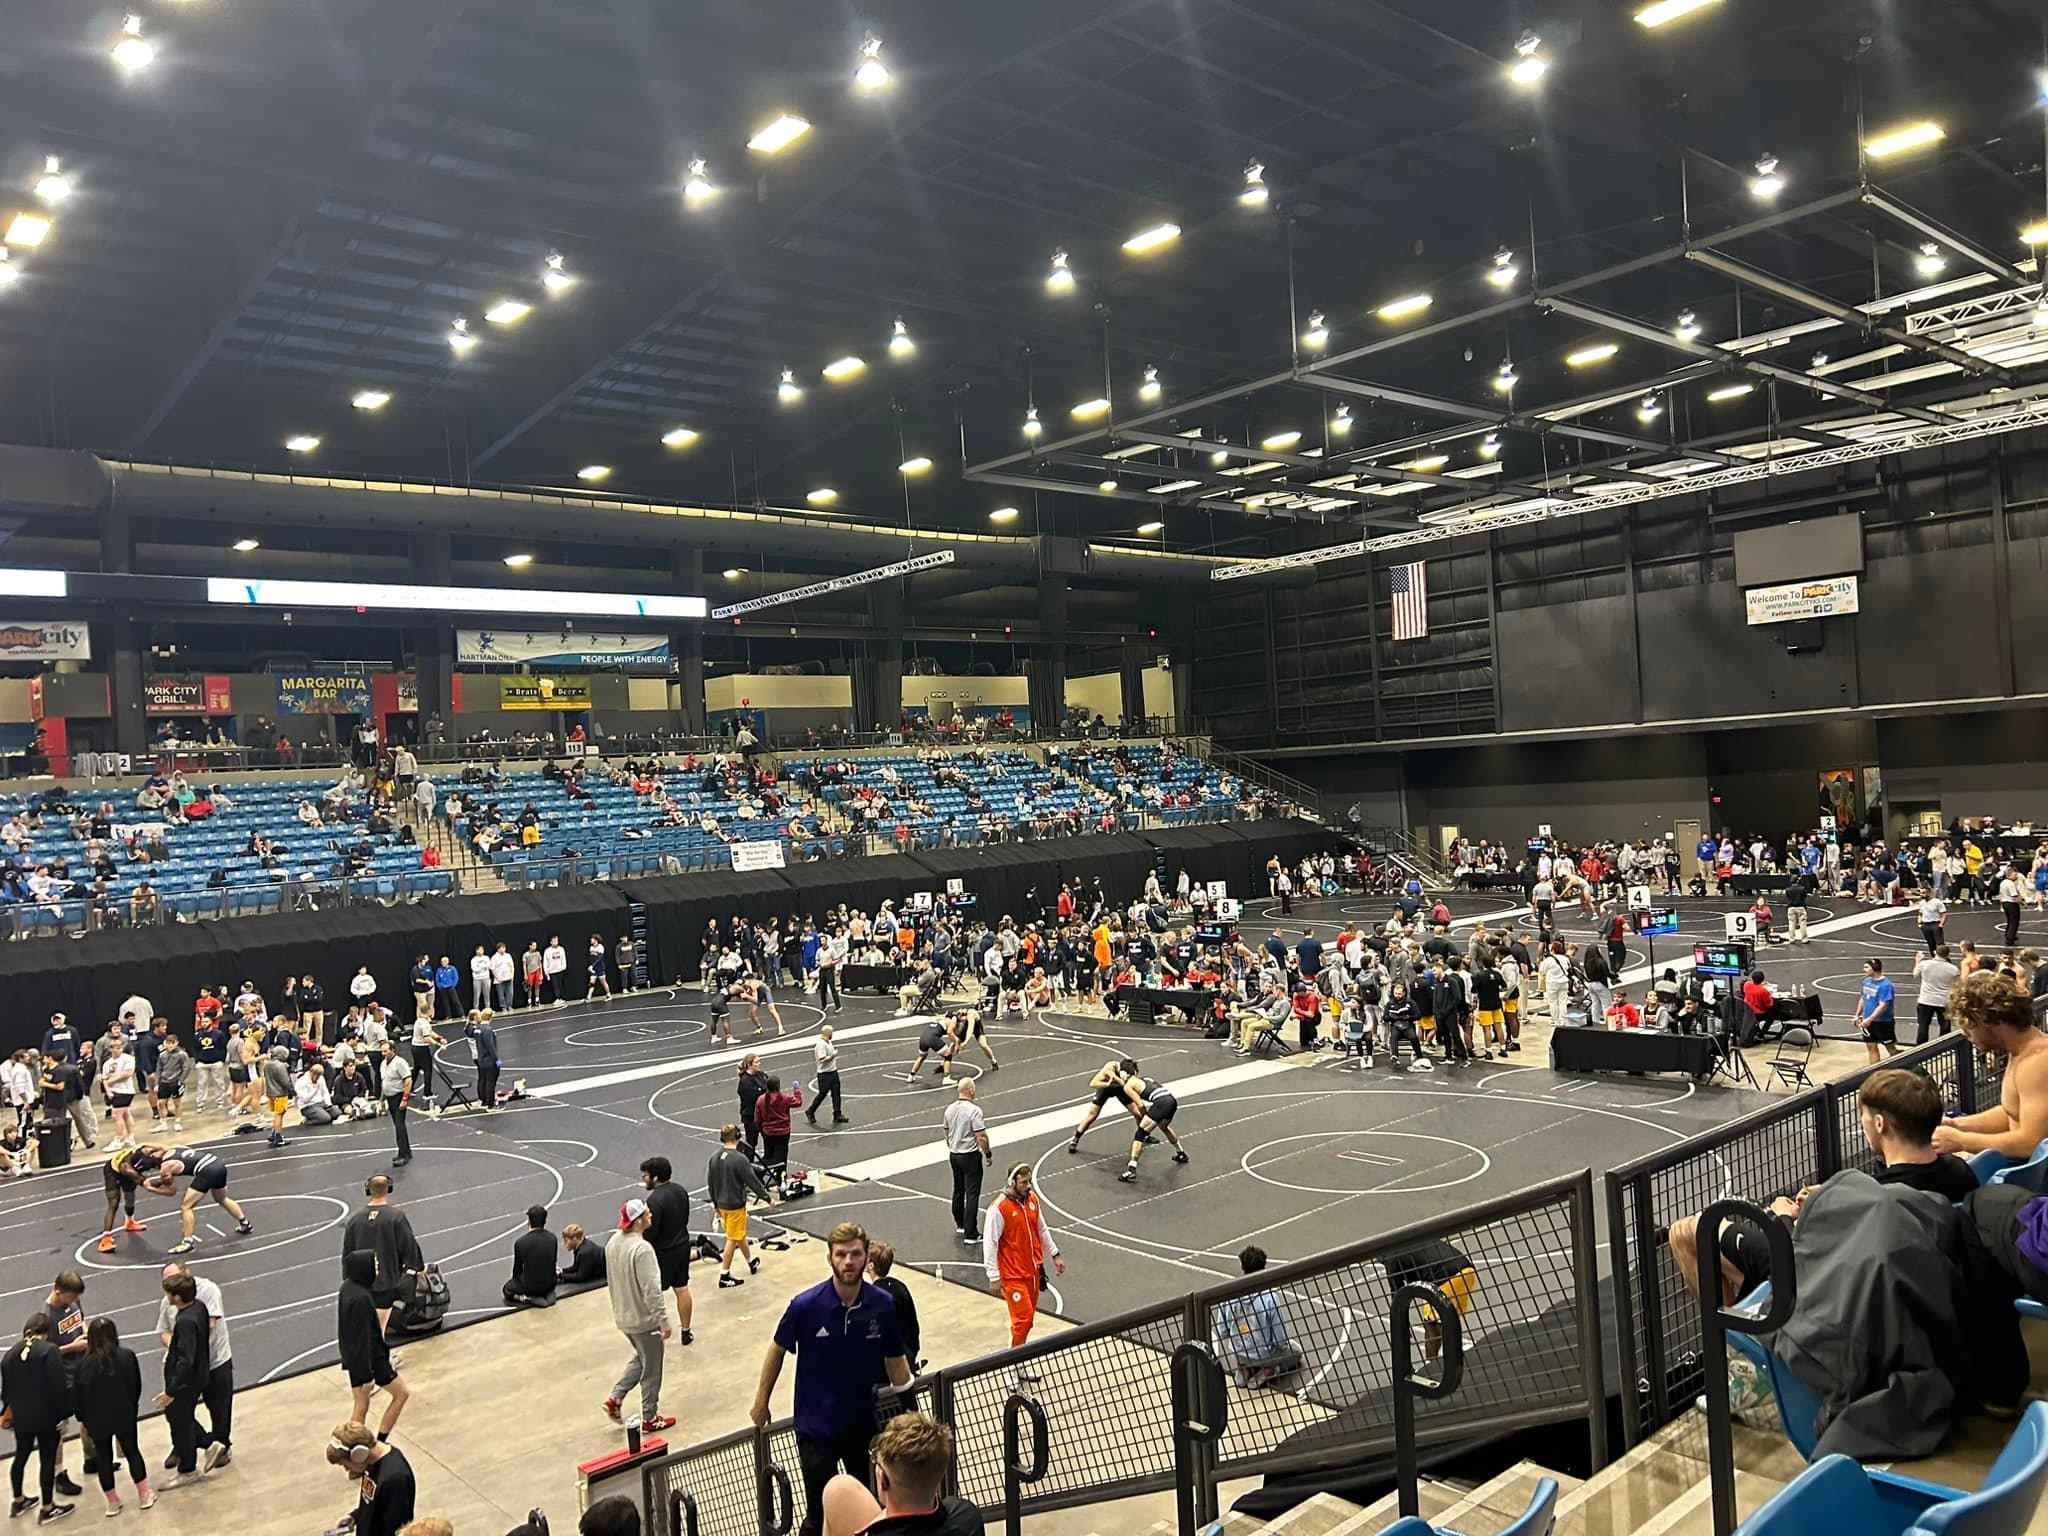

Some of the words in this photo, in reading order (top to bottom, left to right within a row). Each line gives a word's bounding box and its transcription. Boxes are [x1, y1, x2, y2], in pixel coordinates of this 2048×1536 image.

[1750, 593, 1788, 604] Welcome
[1790, 591, 1801, 600] To
[581, 655, 612, 663] PEOPLE
[613, 655, 635, 663] WITH
[636, 655, 668, 664] ENERGY
[281, 677, 367, 690] MARGARITA
[173, 686, 198, 695] CITY
[312, 688, 338, 699] BAR
[153, 695, 187, 704] GRILL
[567, 743, 582, 752] 113
[1826, 817, 1832, 826] 2
[919, 895, 926, 904] 7
[1633, 890, 1642, 904] 4
[1222, 902, 1230, 913] 8
[1735, 916, 1746, 932] 9
